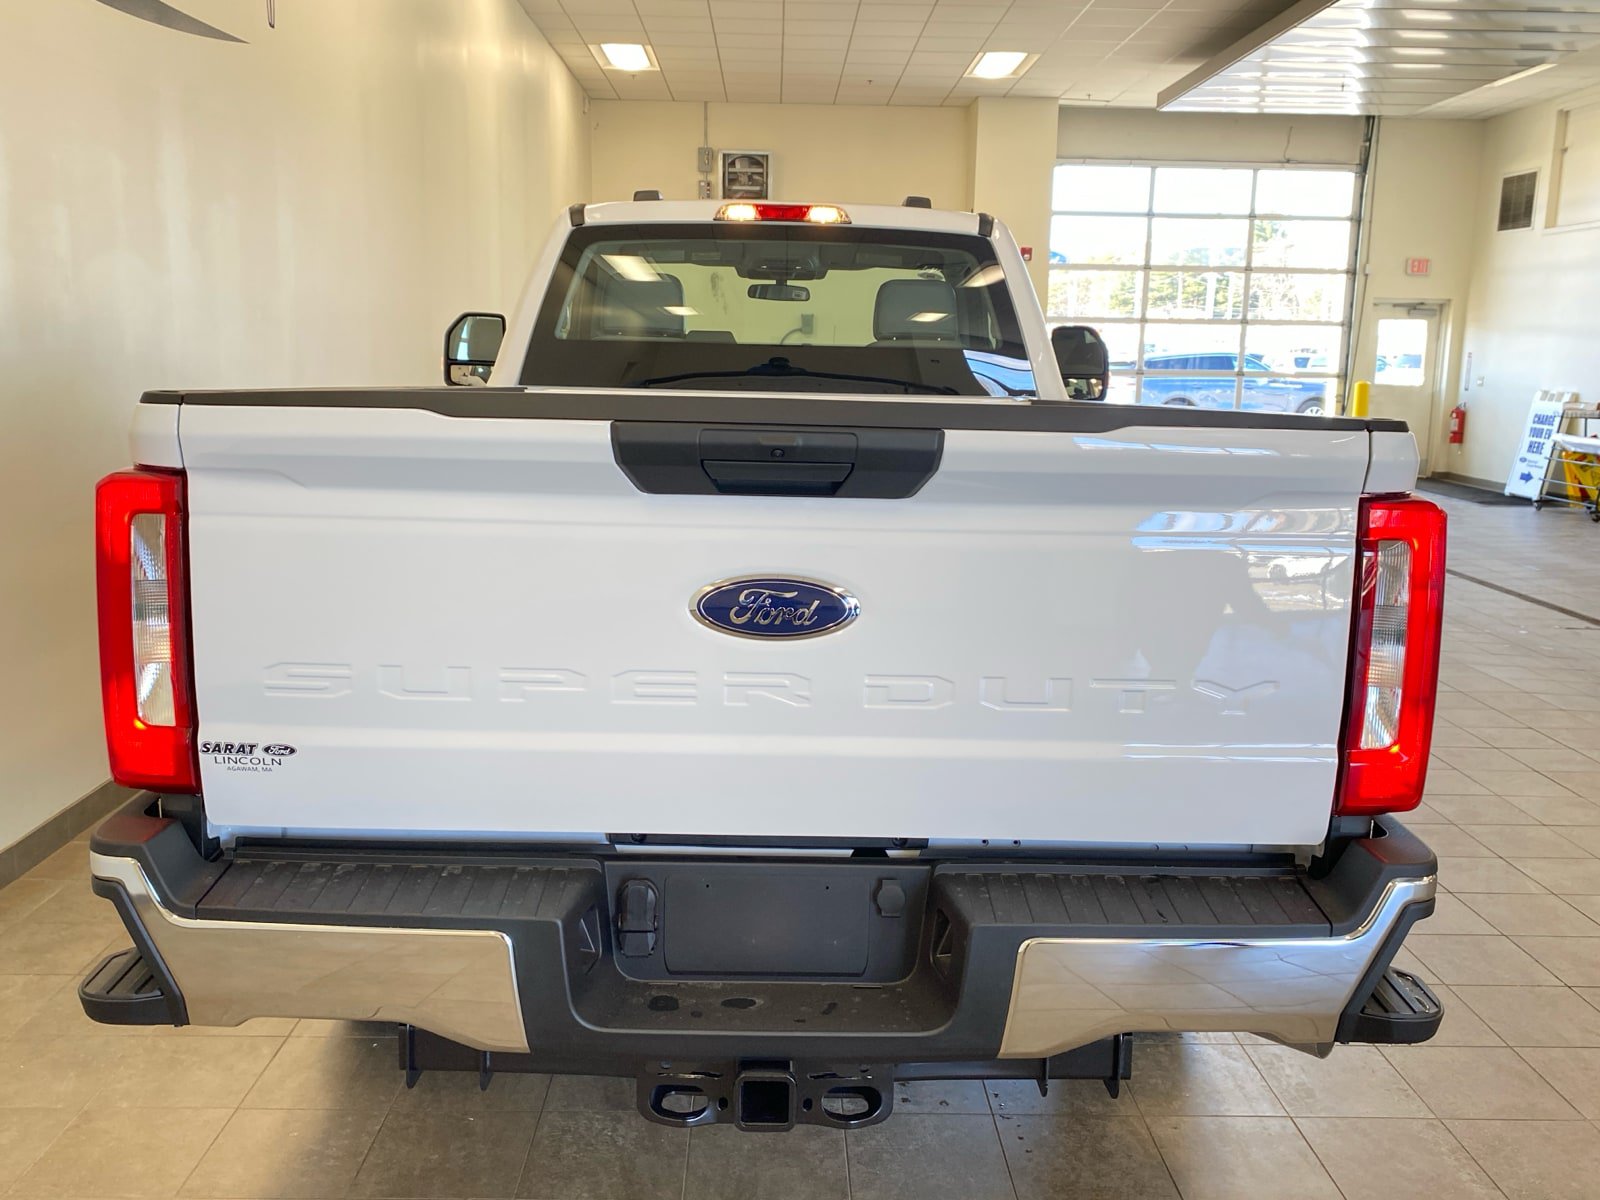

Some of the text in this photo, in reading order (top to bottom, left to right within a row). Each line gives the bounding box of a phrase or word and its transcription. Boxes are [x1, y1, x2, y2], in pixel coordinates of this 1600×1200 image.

[1411, 259, 1428, 273] EXIT
[1532, 413, 1555, 426] CHARGE
[1529, 427, 1553, 440] YOUR EV
[1527, 440, 1545, 455] HERE
[729, 588, 820, 626] Ford
[263, 662, 1280, 716] SUPER DUTY
[201, 742, 292, 755] SARAT Ford
[214, 756, 282, 766] LINCOLN
